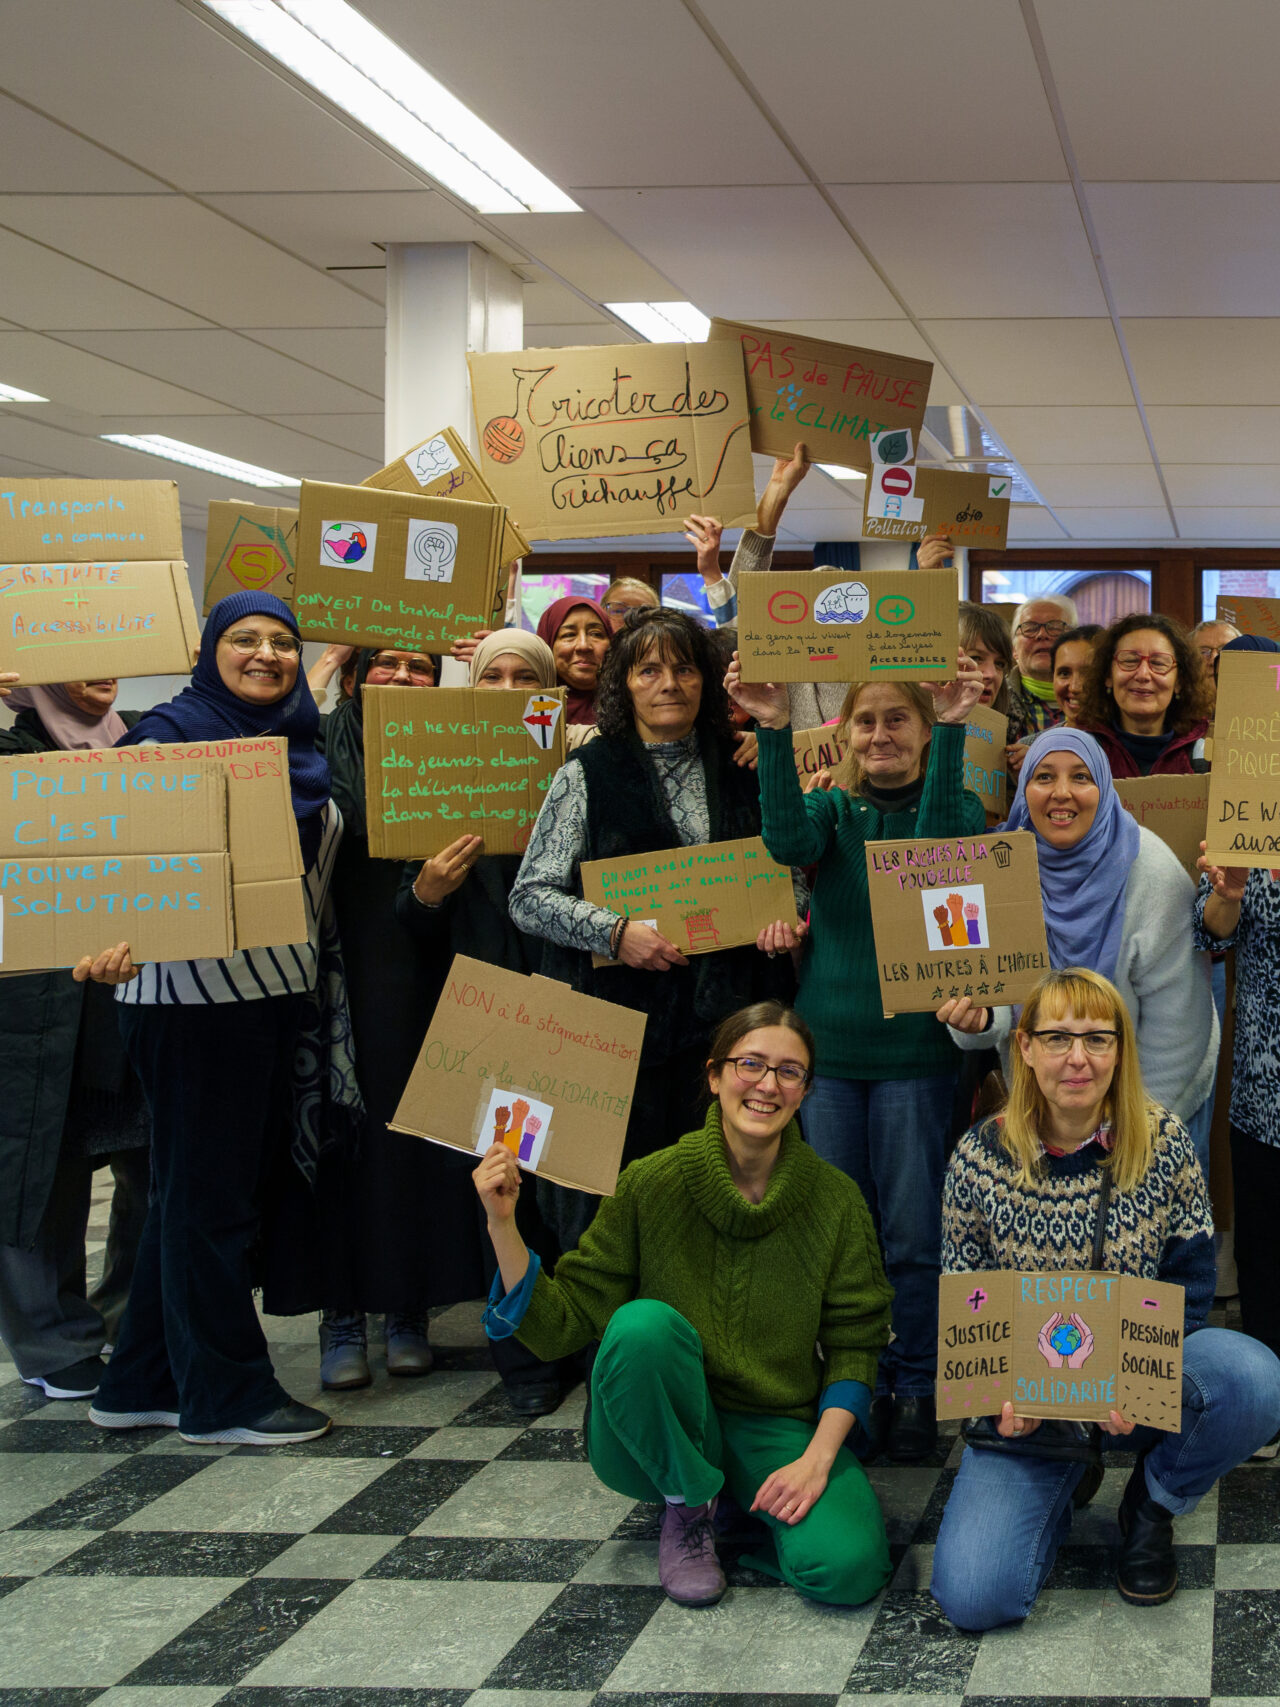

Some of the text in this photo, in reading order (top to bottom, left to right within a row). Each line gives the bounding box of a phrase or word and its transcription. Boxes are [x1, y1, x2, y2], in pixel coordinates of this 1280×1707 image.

[741, 335, 924, 409] PAS de PAUSE
[673, 362, 729, 416] des
[770, 398, 890, 443] le CLIMAT
[2, 491, 126, 523] Transports
[41, 532, 146, 544] en communs
[866, 518, 928, 539] Pollution
[745, 631, 763, 641] de
[821, 632, 852, 640] vivent
[866, 631, 882, 640] de
[808, 646, 835, 655] RUE
[385, 721, 414, 737] ON
[448, 720, 489, 735] VEUT
[493, 725, 528, 738] pas
[229, 762, 281, 780] DES
[381, 748, 540, 776] des jeunes dans
[408, 777, 529, 803] délinquance
[382, 801, 433, 824] dans
[469, 802, 541, 828] drogu
[1219, 800, 1249, 822] DE
[14, 813, 127, 845] C'EST
[147, 855, 203, 873] DES
[872, 850, 900, 874] LES
[971, 843, 988, 860] LA
[602, 871, 618, 888] ON
[621, 867, 648, 883] VEUT
[654, 860, 677, 875] QUE
[884, 963, 910, 982] LES
[916, 958, 973, 986] AUTRES
[447, 982, 638, 1061] NON à la stigmatisation
[425, 1040, 516, 1086] OUI à la
[1021, 1277, 1118, 1304] RESPECT
